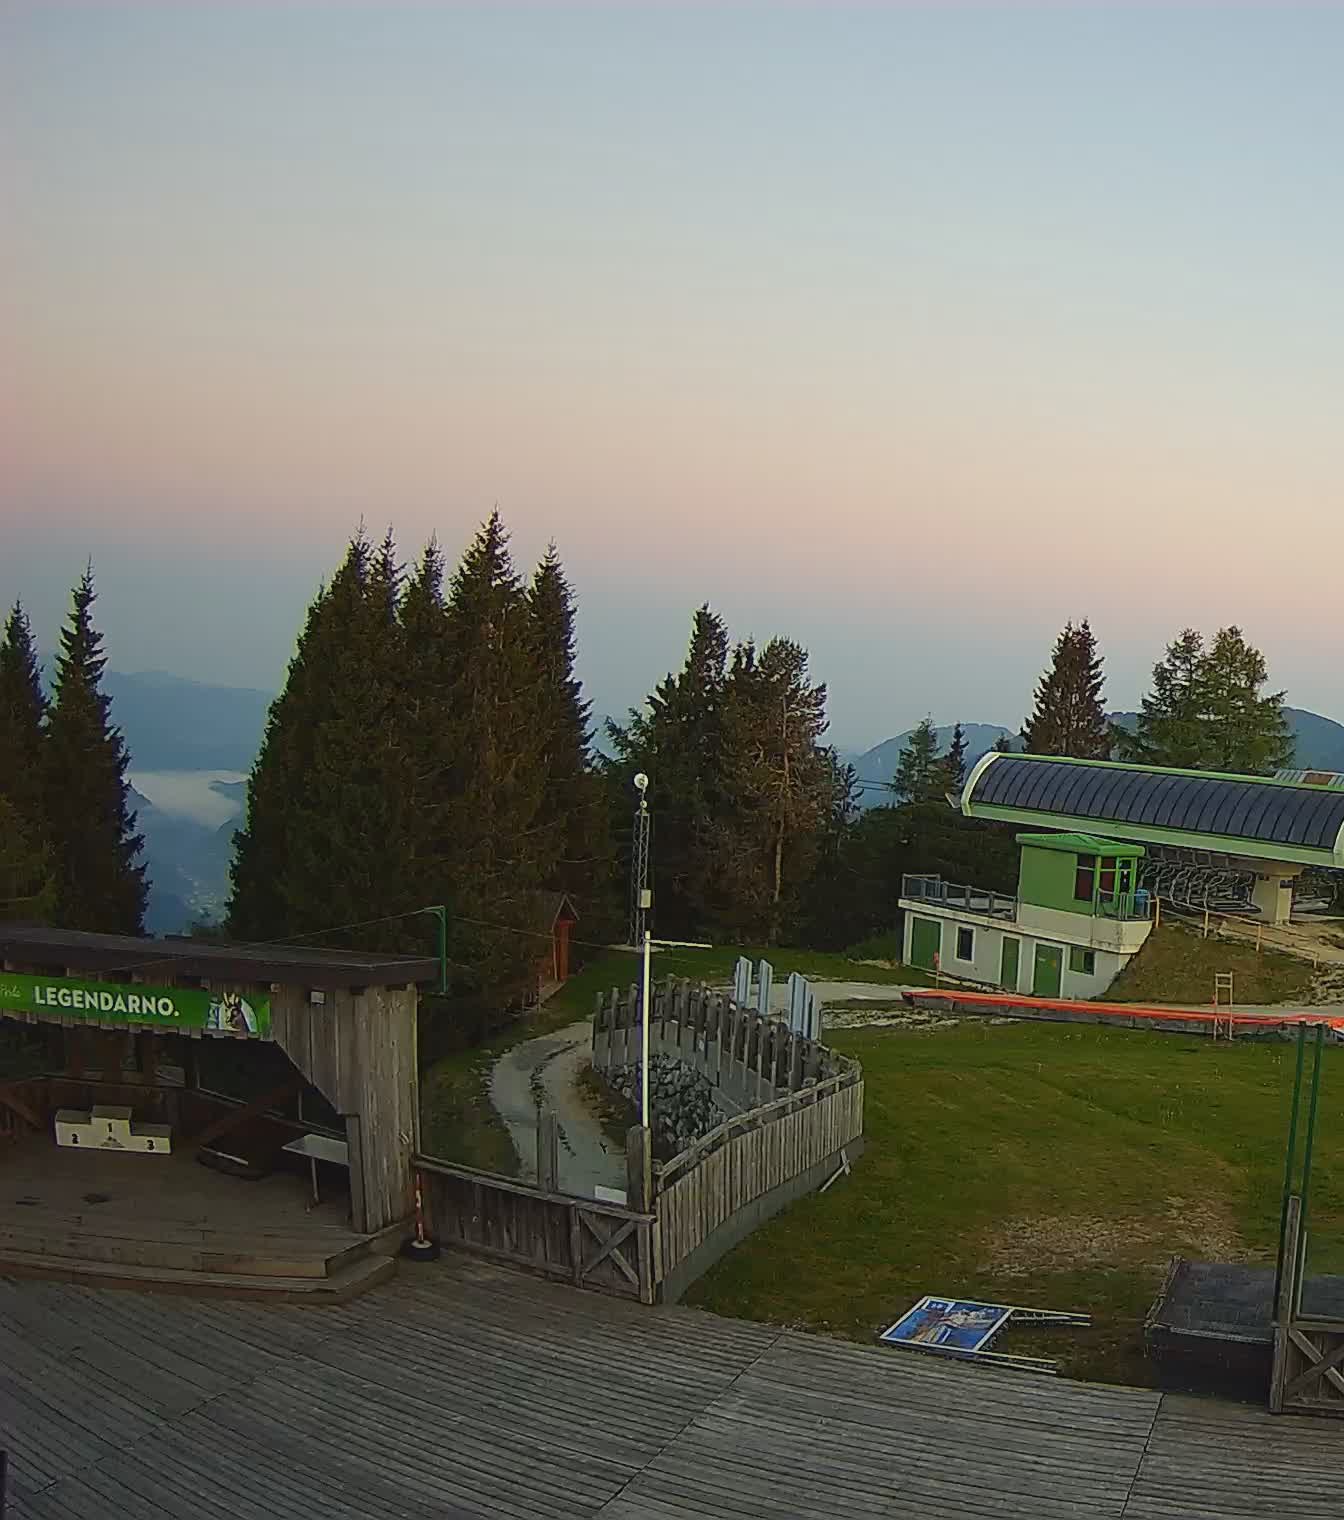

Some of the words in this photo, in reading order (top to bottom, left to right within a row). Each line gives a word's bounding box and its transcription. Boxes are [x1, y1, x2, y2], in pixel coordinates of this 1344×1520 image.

[34, 985, 180, 1017] LEGENDARNO.
[71, 1133, 79, 1145] 2
[146, 1139, 155, 1151] 3
